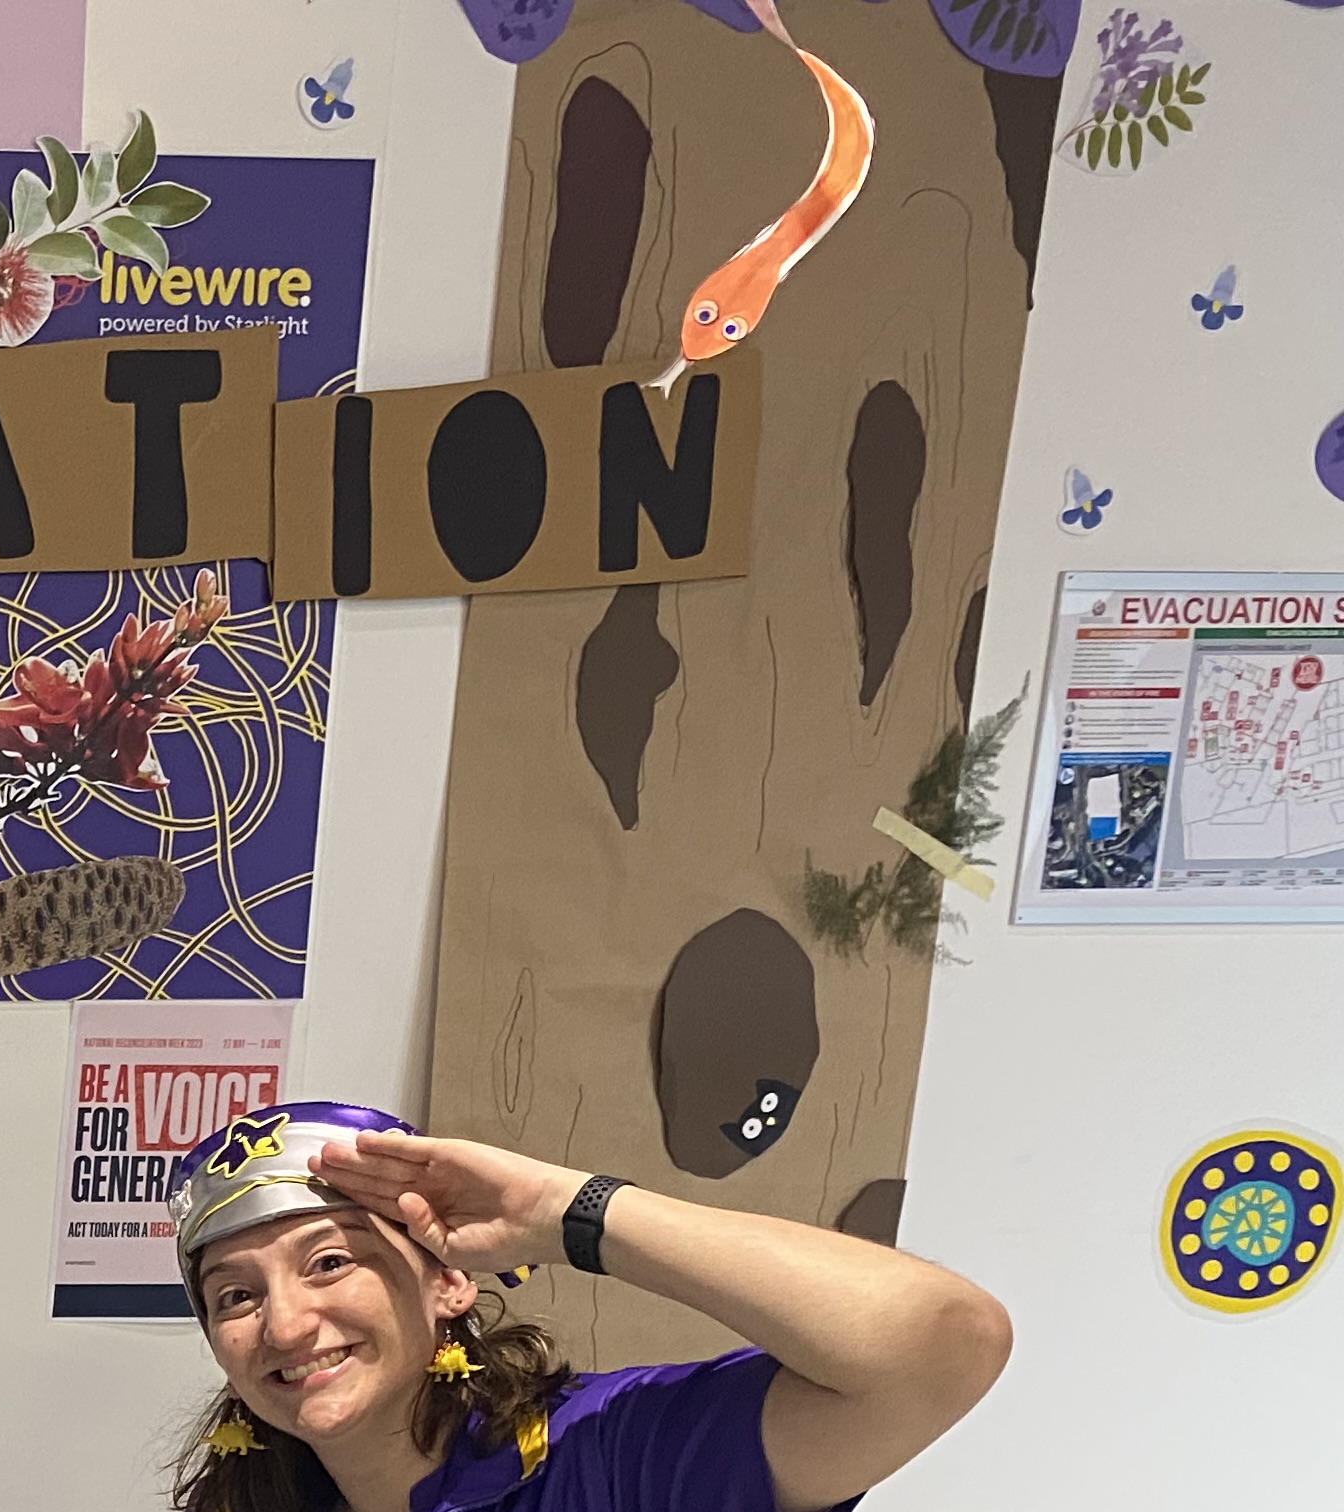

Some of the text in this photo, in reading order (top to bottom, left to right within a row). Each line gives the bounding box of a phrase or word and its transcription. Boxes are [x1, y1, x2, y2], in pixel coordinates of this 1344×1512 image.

[99, 314, 310, 339] powered by Stght
[1120, 597, 1324, 624] EVACUATION
[78, 1064, 111, 1103] BE
[113, 1064, 129, 1103] A
[75, 1107, 129, 1151] FOR
[67, 1221, 87, 1238] ACT
[89, 1221, 120, 1238] TODAY
[120, 1221, 141, 1238] FOR
[141, 1221, 148, 1238] A
